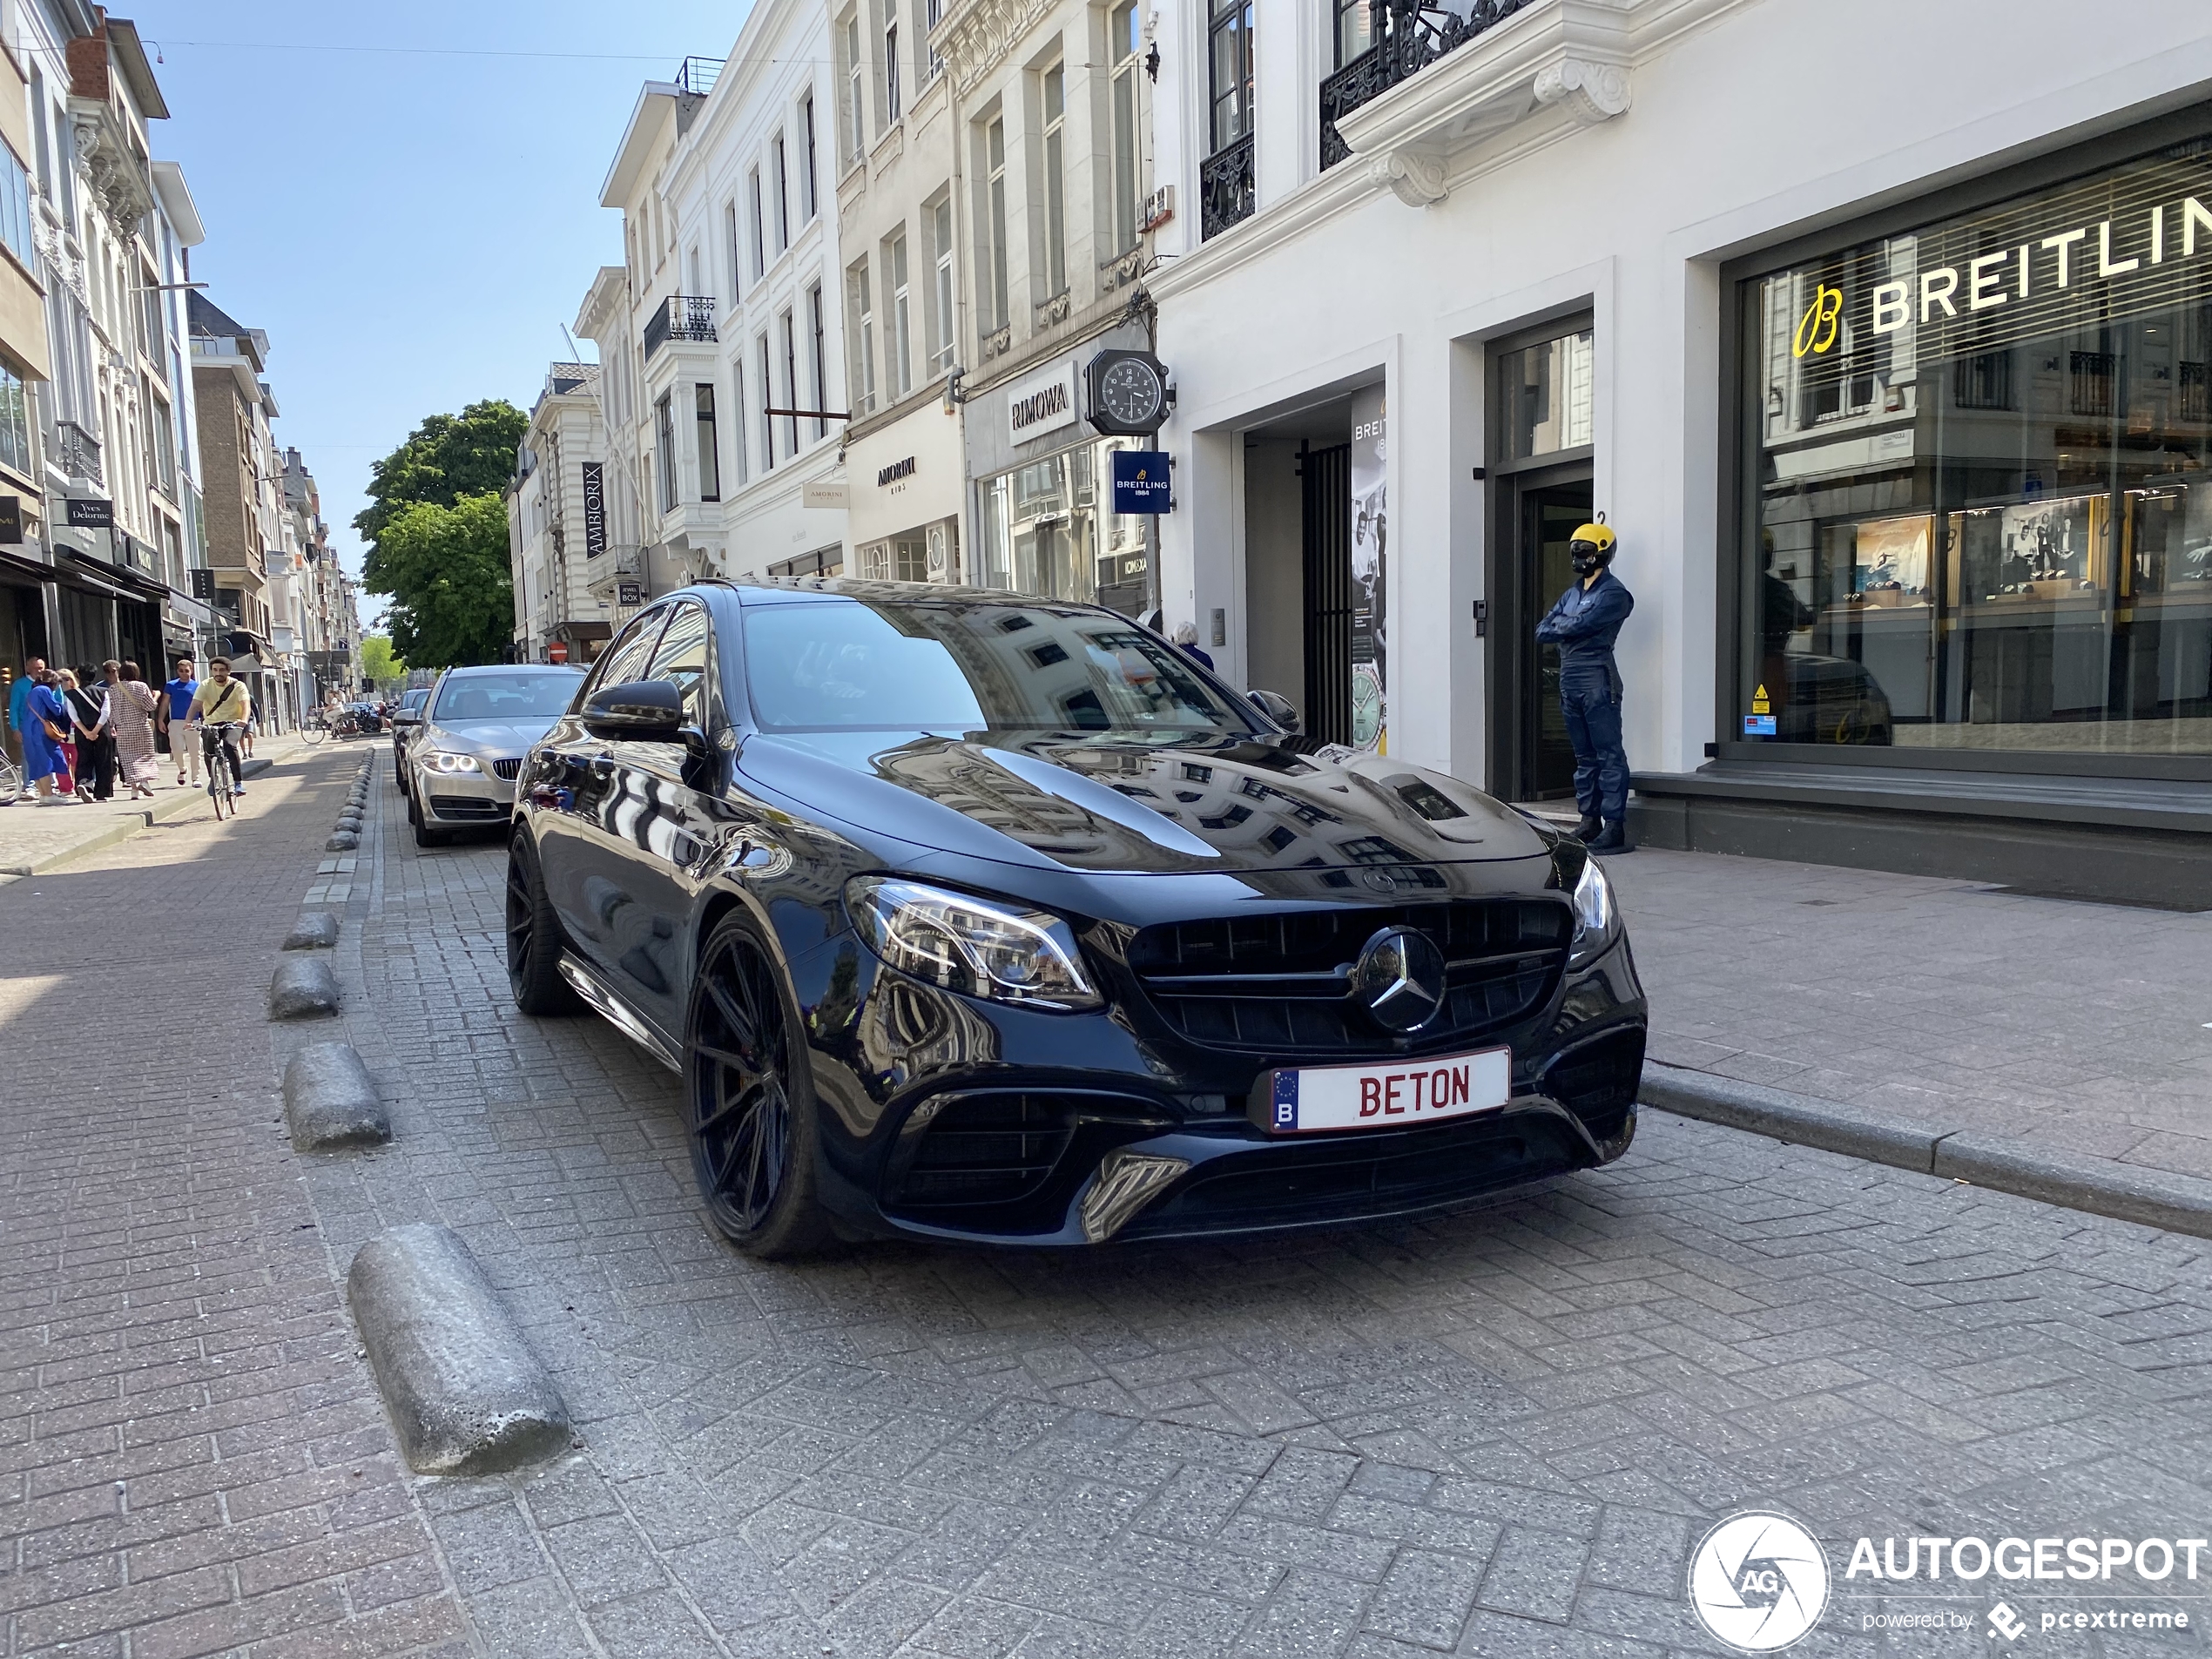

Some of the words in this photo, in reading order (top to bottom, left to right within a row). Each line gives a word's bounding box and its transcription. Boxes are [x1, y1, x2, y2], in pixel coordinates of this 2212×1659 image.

[1012, 382, 1069, 430] RIMOWA
[878, 455, 916, 487] AMORINI
[891, 483, 906, 495] KIDS
[1116, 481, 1168, 489] BREITLING
[72, 510, 110, 520] Delorme
[80, 503, 101, 512] Yves
[585, 465, 604, 554] AMBIORIX
[1359, 1065, 1469, 1117] BETON
[1278, 1103, 1293, 1122] B
